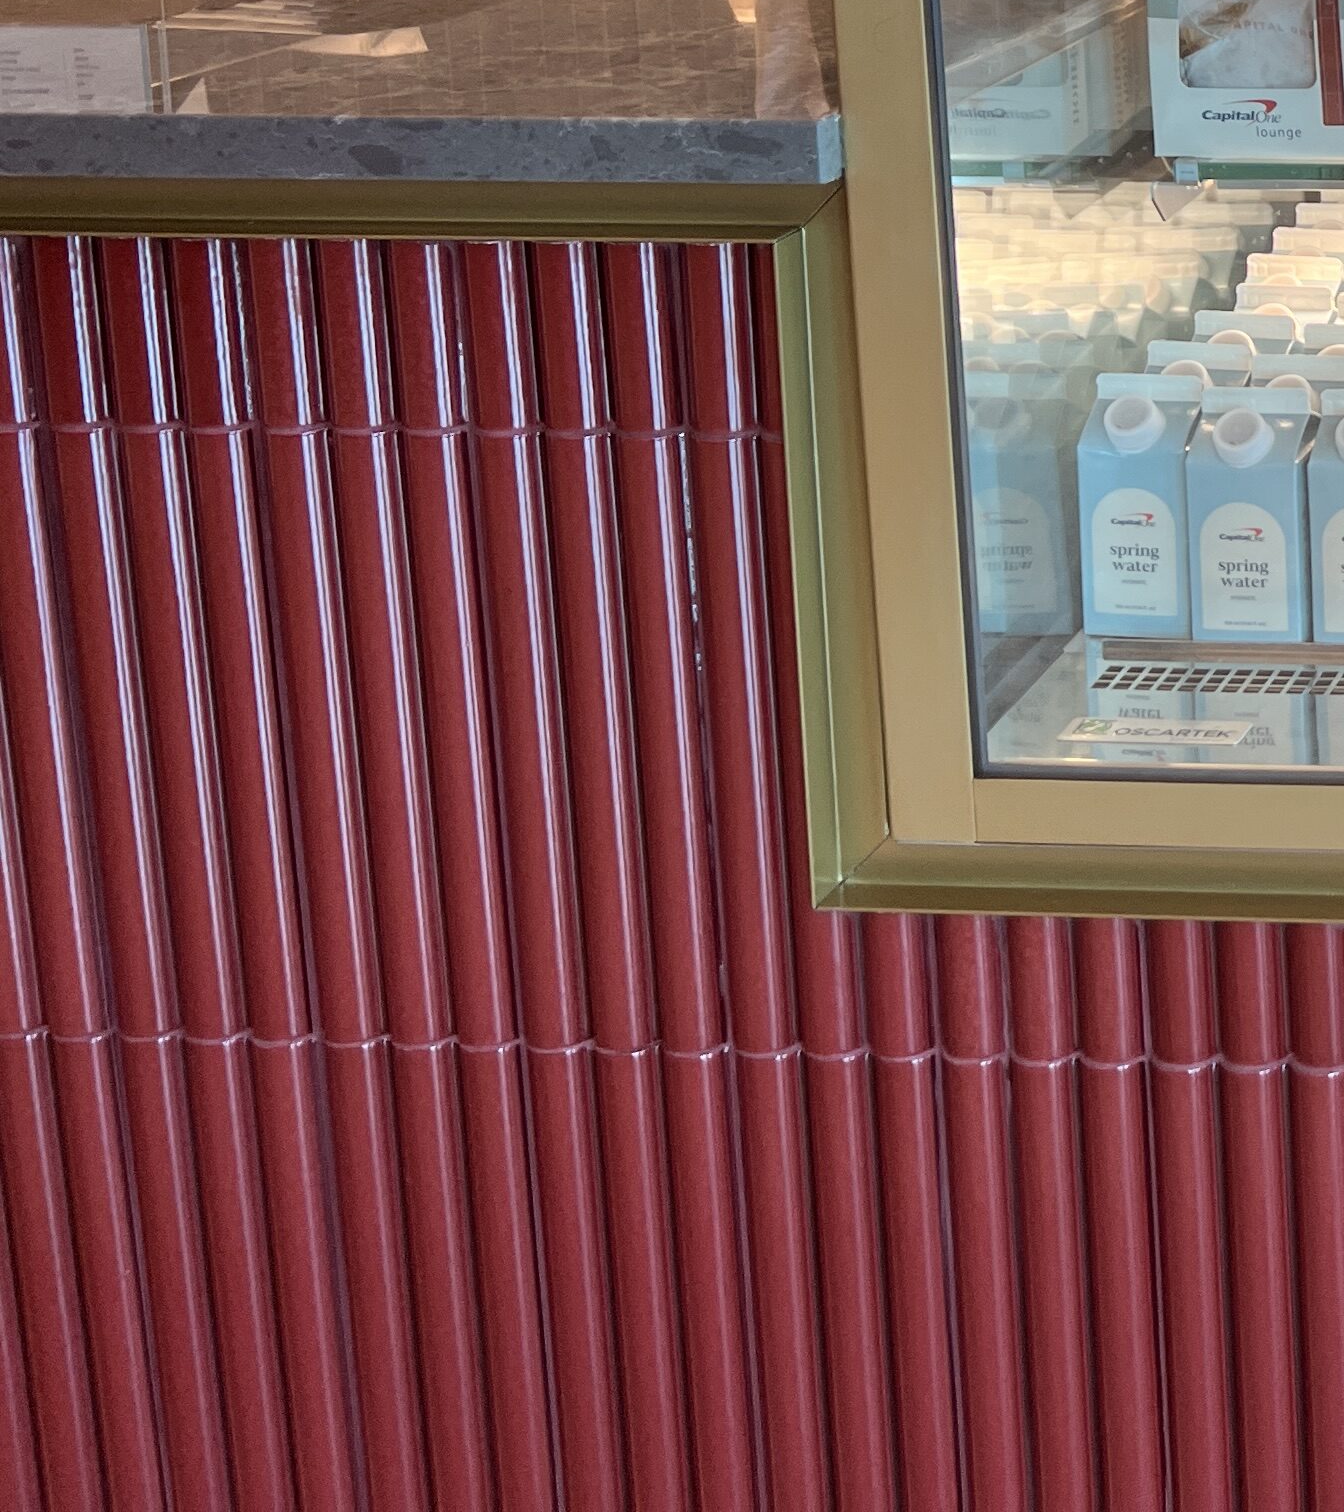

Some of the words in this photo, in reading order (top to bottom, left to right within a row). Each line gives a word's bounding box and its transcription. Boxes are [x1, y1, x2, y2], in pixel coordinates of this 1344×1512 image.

[1256, 126, 1302, 141] lounge
[1110, 542, 1160, 561] spring
[1111, 559, 1158, 573] water
